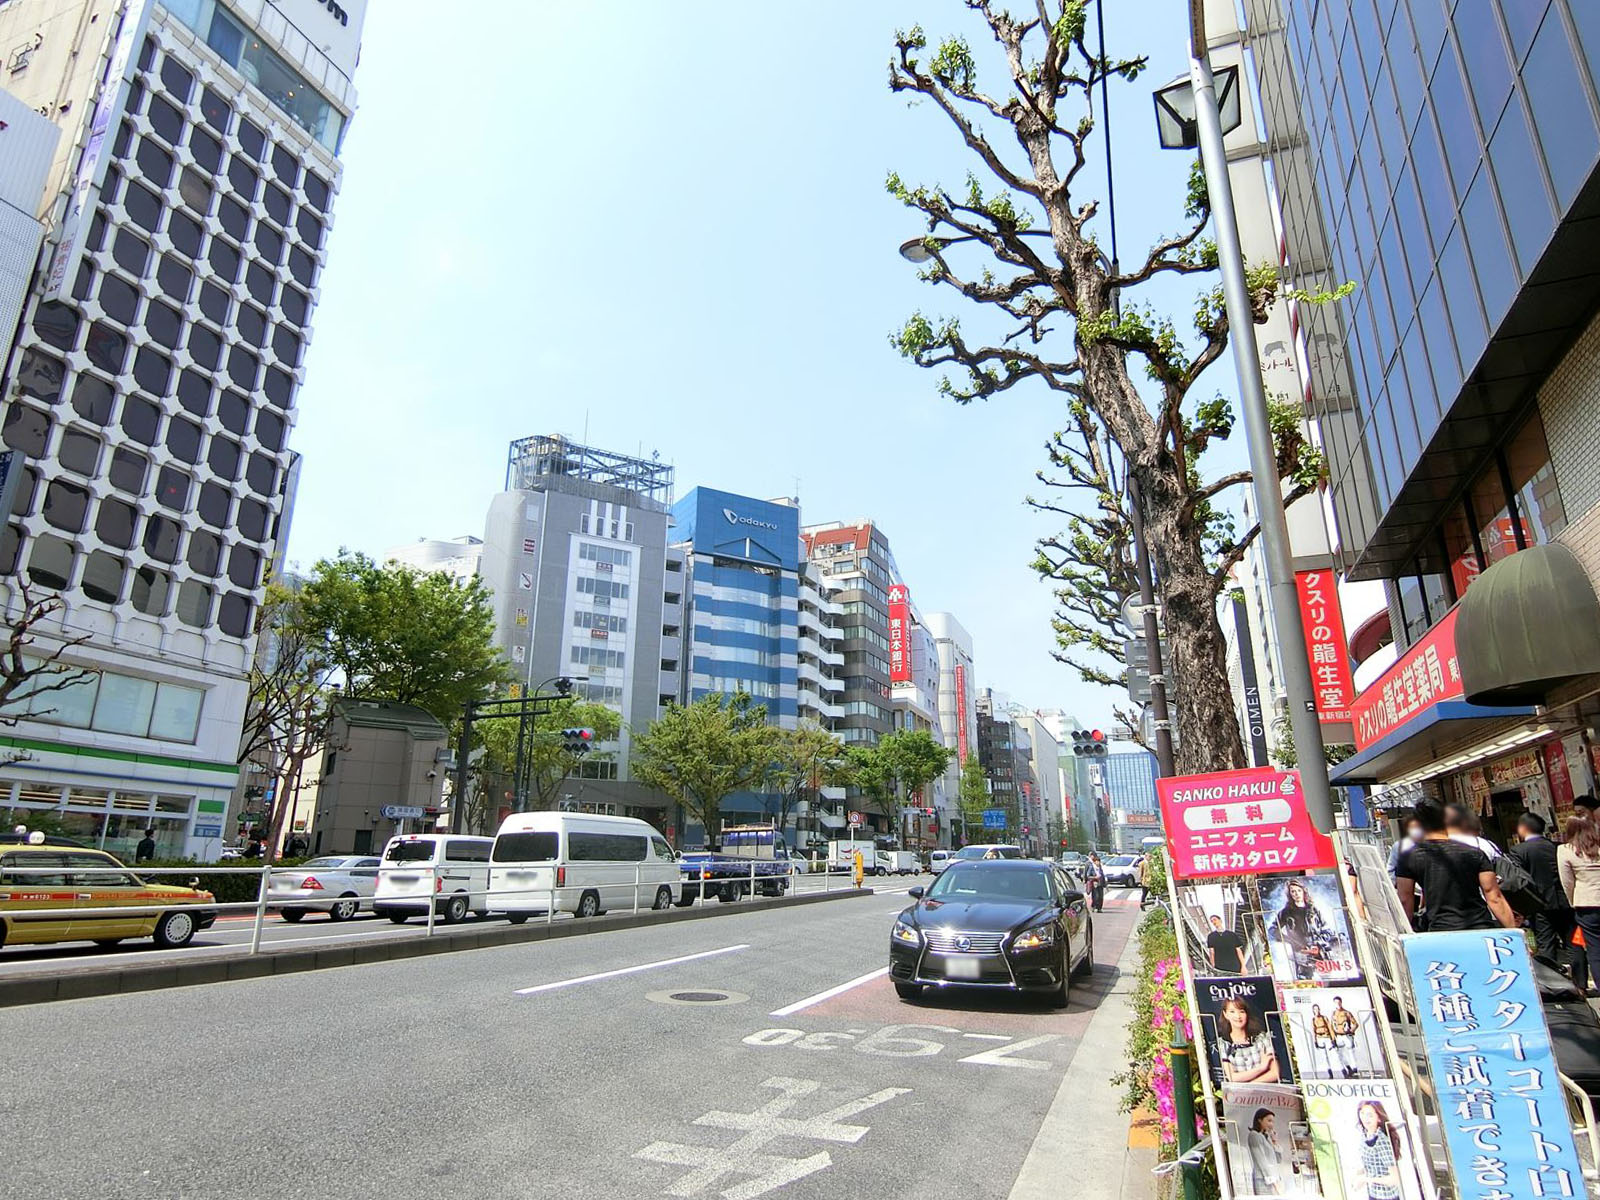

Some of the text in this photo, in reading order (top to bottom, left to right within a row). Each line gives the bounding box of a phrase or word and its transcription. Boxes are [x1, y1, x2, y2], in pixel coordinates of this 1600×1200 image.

[739, 517, 778, 530] odakyu
[890, 619, 903, 672] 東日本銀行
[1304, 573, 1345, 709] クスリの龍生堂
[1359, 643, 1446, 744] クスリの龍生堂薬局
[1246, 686, 1262, 737] OIMEN
[1172, 780, 1277, 803] SANKO HAKUI
[1210, 804, 1264, 825] 無料
[1190, 827, 1296, 849] ユニフォーム
[1193, 846, 1299, 872] 新作カタログ
[1307, 1083, 1392, 1099] BONOFFICE
